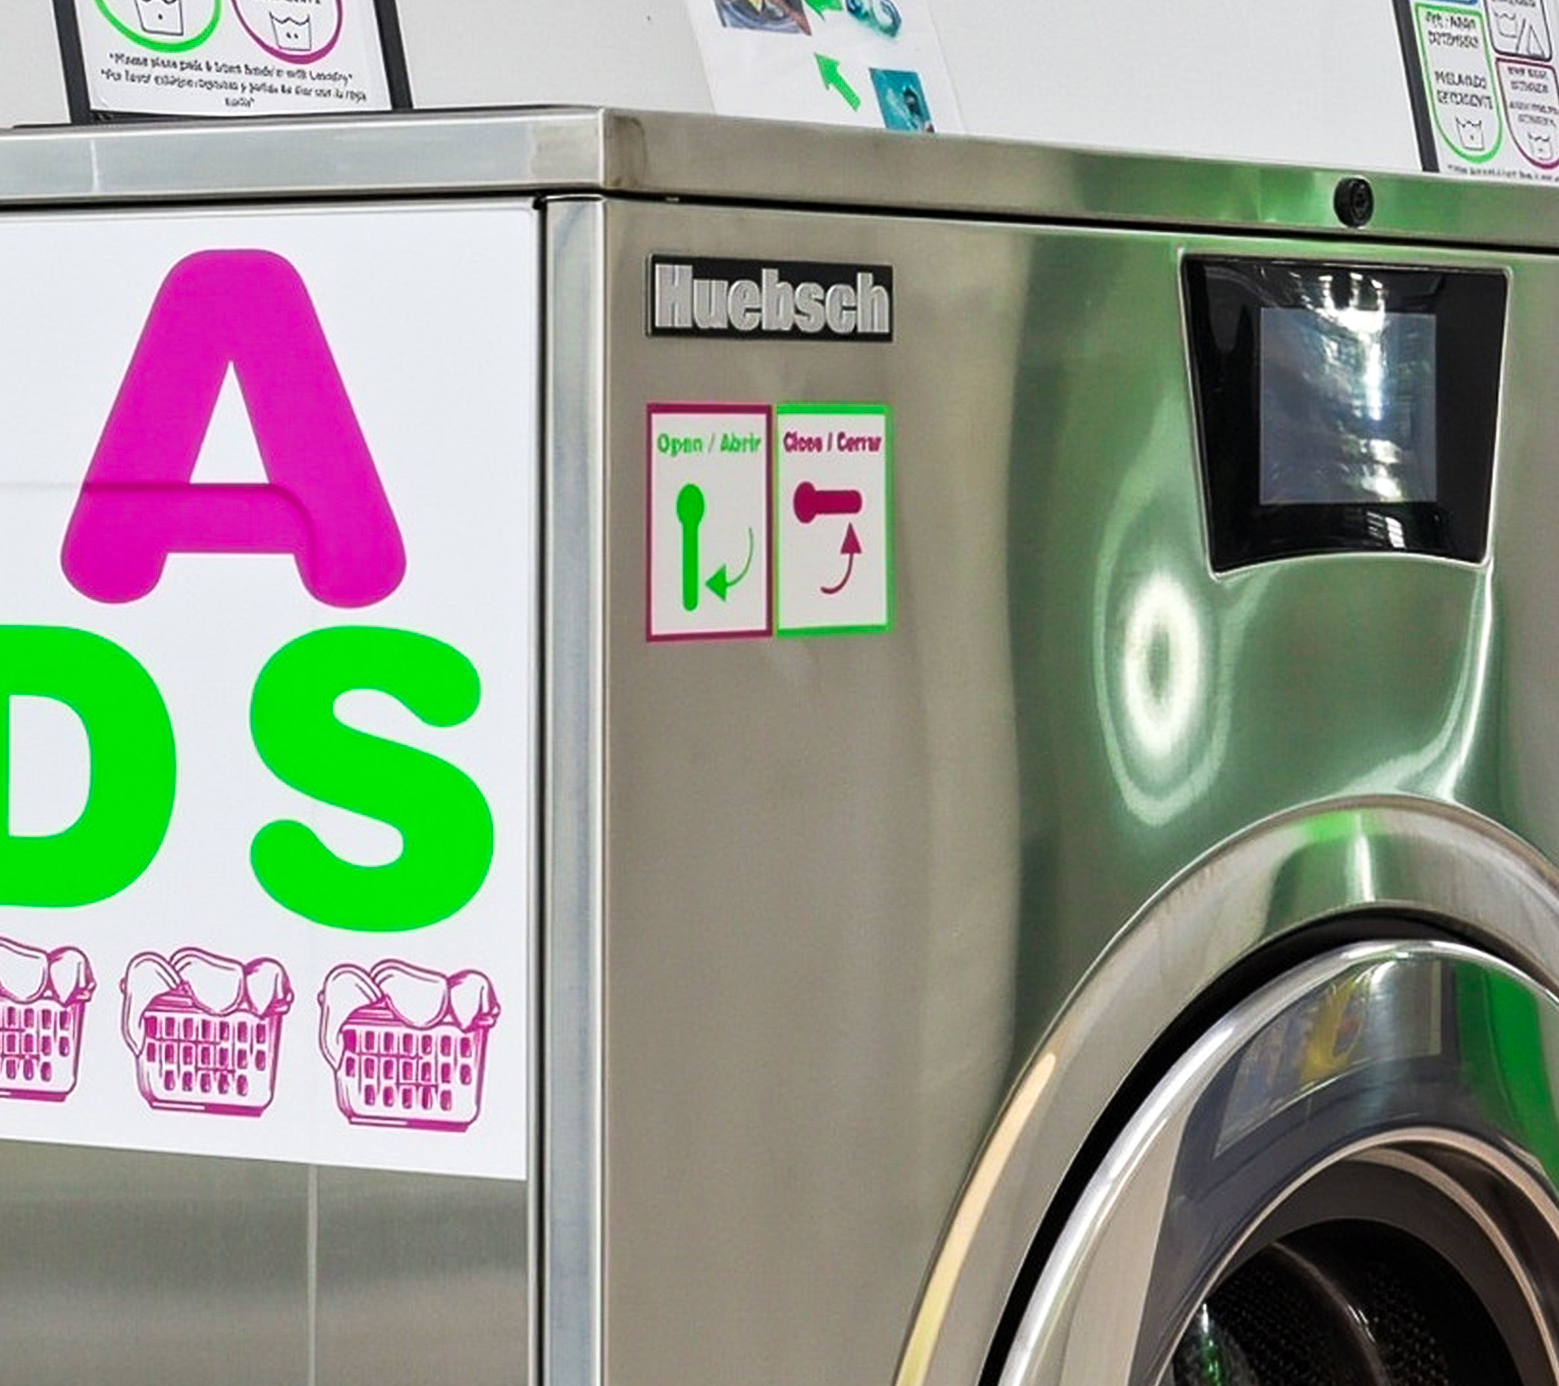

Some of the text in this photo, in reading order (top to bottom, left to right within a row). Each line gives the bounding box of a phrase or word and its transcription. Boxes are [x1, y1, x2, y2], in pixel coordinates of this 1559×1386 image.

[654, 263, 890, 335] Huebsch
[657, 432, 703, 457] Open
[720, 431, 762, 453] Abrir
[783, 431, 823, 452] Close
